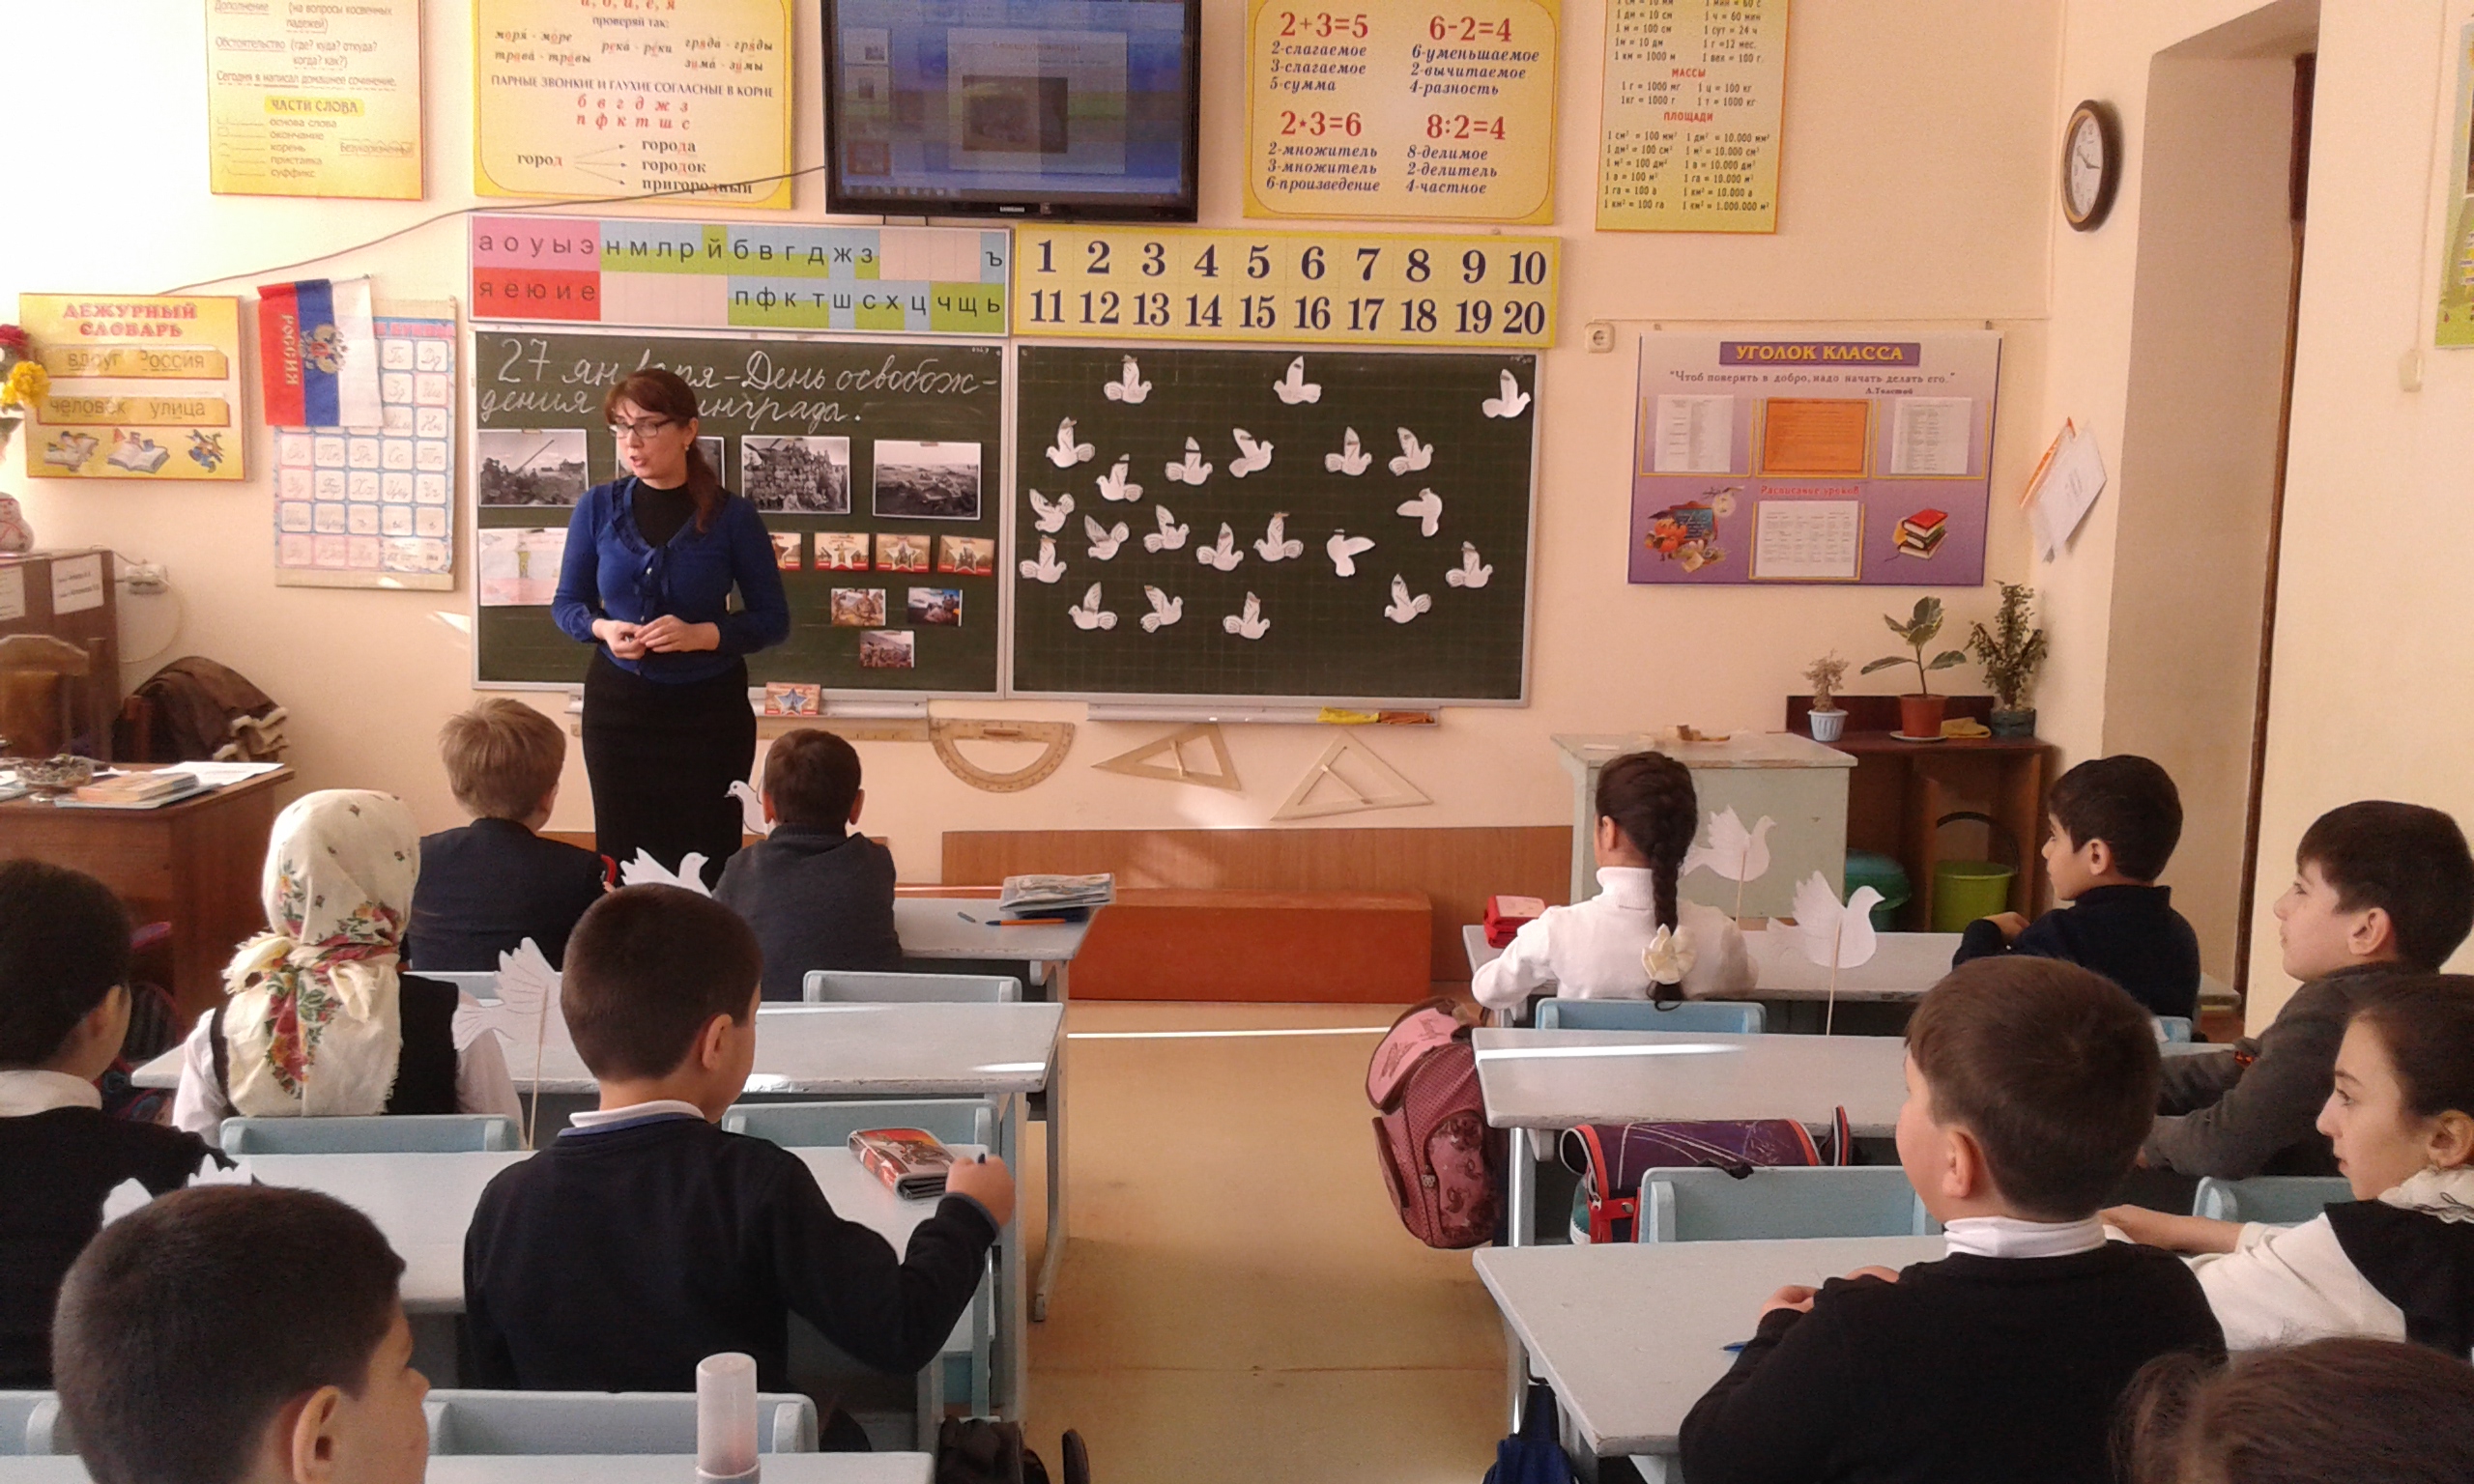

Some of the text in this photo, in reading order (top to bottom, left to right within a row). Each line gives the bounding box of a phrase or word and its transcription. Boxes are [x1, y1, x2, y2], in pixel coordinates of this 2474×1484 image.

[1280, 12, 1368, 40] 2+3=5
[1429, 15, 1512, 43] 6-2=4
[1271, 41, 1367, 58] 2-слагаемое
[1411, 43, 1540, 63] 6-уменьшаемое
[1647, 51, 1667, 61] 1000
[1270, 58, 1366, 75] 3-слагаемое
[1410, 63, 1527, 80] 2-вычитаемое
[1671, 68, 1707, 77] МАССЫ
[491, 74, 774, 98] ПАРНЫЕ ЗВОНКИЕ И ГЛУХИЕ СОГЛАСНЫЕ В КОРНЕ
[1270, 76, 1337, 94] 5-сумма
[1409, 78, 1499, 98] 4-разность
[272, 100, 358, 113] ЧАСТИ СЛОВА
[1648, 95, 1668, 105] 1000
[270, 119, 337, 128] основа слова
[1663, 112, 1713, 123] ПЛОЩАДИ
[1426, 114, 1507, 140] 8:2=4
[271, 144, 305, 154] корень
[642, 140, 697, 155] города
[1268, 142, 1379, 158] 2-множитель
[1407, 144, 1488, 161] 8-делимое
[517, 153, 563, 168] город
[642, 158, 706, 175] городок
[1267, 158, 1378, 176] 3-множитель
[271, 169, 316, 179] суффикс
[1406, 161, 1498, 179] 2-делитель
[1266, 177, 1381, 195] 6-произведение
[1405, 179, 1487, 195] 4-частное
[1037, 240, 1546, 285] 1 2 3 4 5 6 7 8 9 10
[63, 301, 198, 320] ДЕЖУРНЫЙ
[1030, 289, 1545, 335] 11 12 13 14 15 16 17 18 19 20
[79, 322, 183, 337] СЛОВАРЬ
[280, 313, 299, 385] РОССИЯ
[1737, 344, 1904, 361] УГОЛОК КЛАССА
[498, 338, 551, 383] 27
[1707, 374, 1759, 385] поверить
[1813, 374, 1840, 384] надо
[1844, 374, 1883, 384] начать
[1885, 375, 1924, 385] делать
[150, 401, 206, 419] улица
[481, 388, 596, 422] дения
[1761, 485, 1860, 497] Расписание уроков
